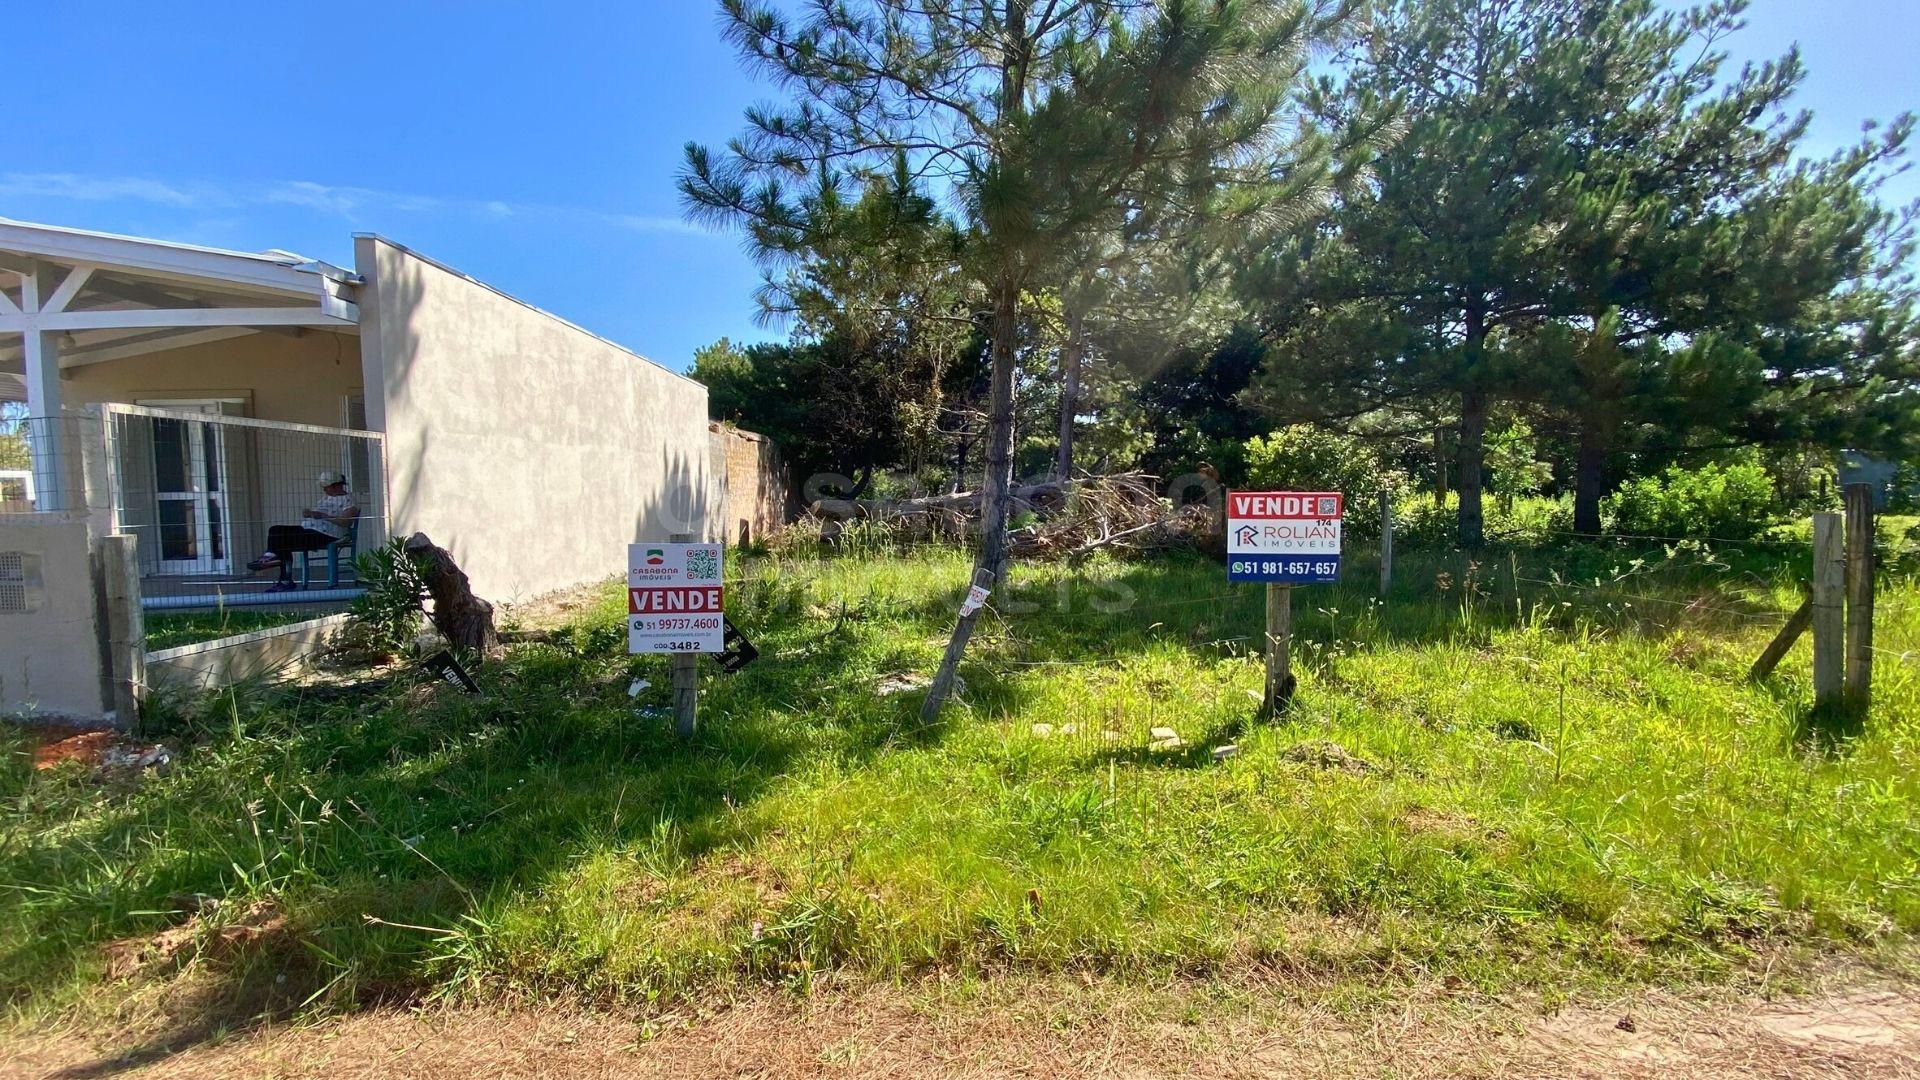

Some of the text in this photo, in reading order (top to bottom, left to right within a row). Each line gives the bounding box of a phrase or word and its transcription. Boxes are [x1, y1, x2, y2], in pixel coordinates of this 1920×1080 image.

[1235, 496, 1315, 516] VENDE
[1316, 519, 1332, 527] 174
[1264, 526, 1336, 539] ROLIAN
[1264, 539, 1336, 548] IMÓVEIS
[1244, 561, 1337, 575] 51 981-657-657
[632, 590, 719, 610] VENDE
[646, 621, 656, 630] 51
[658, 618, 719, 630] 99737.4600
[670, 641, 701, 651] 3482
